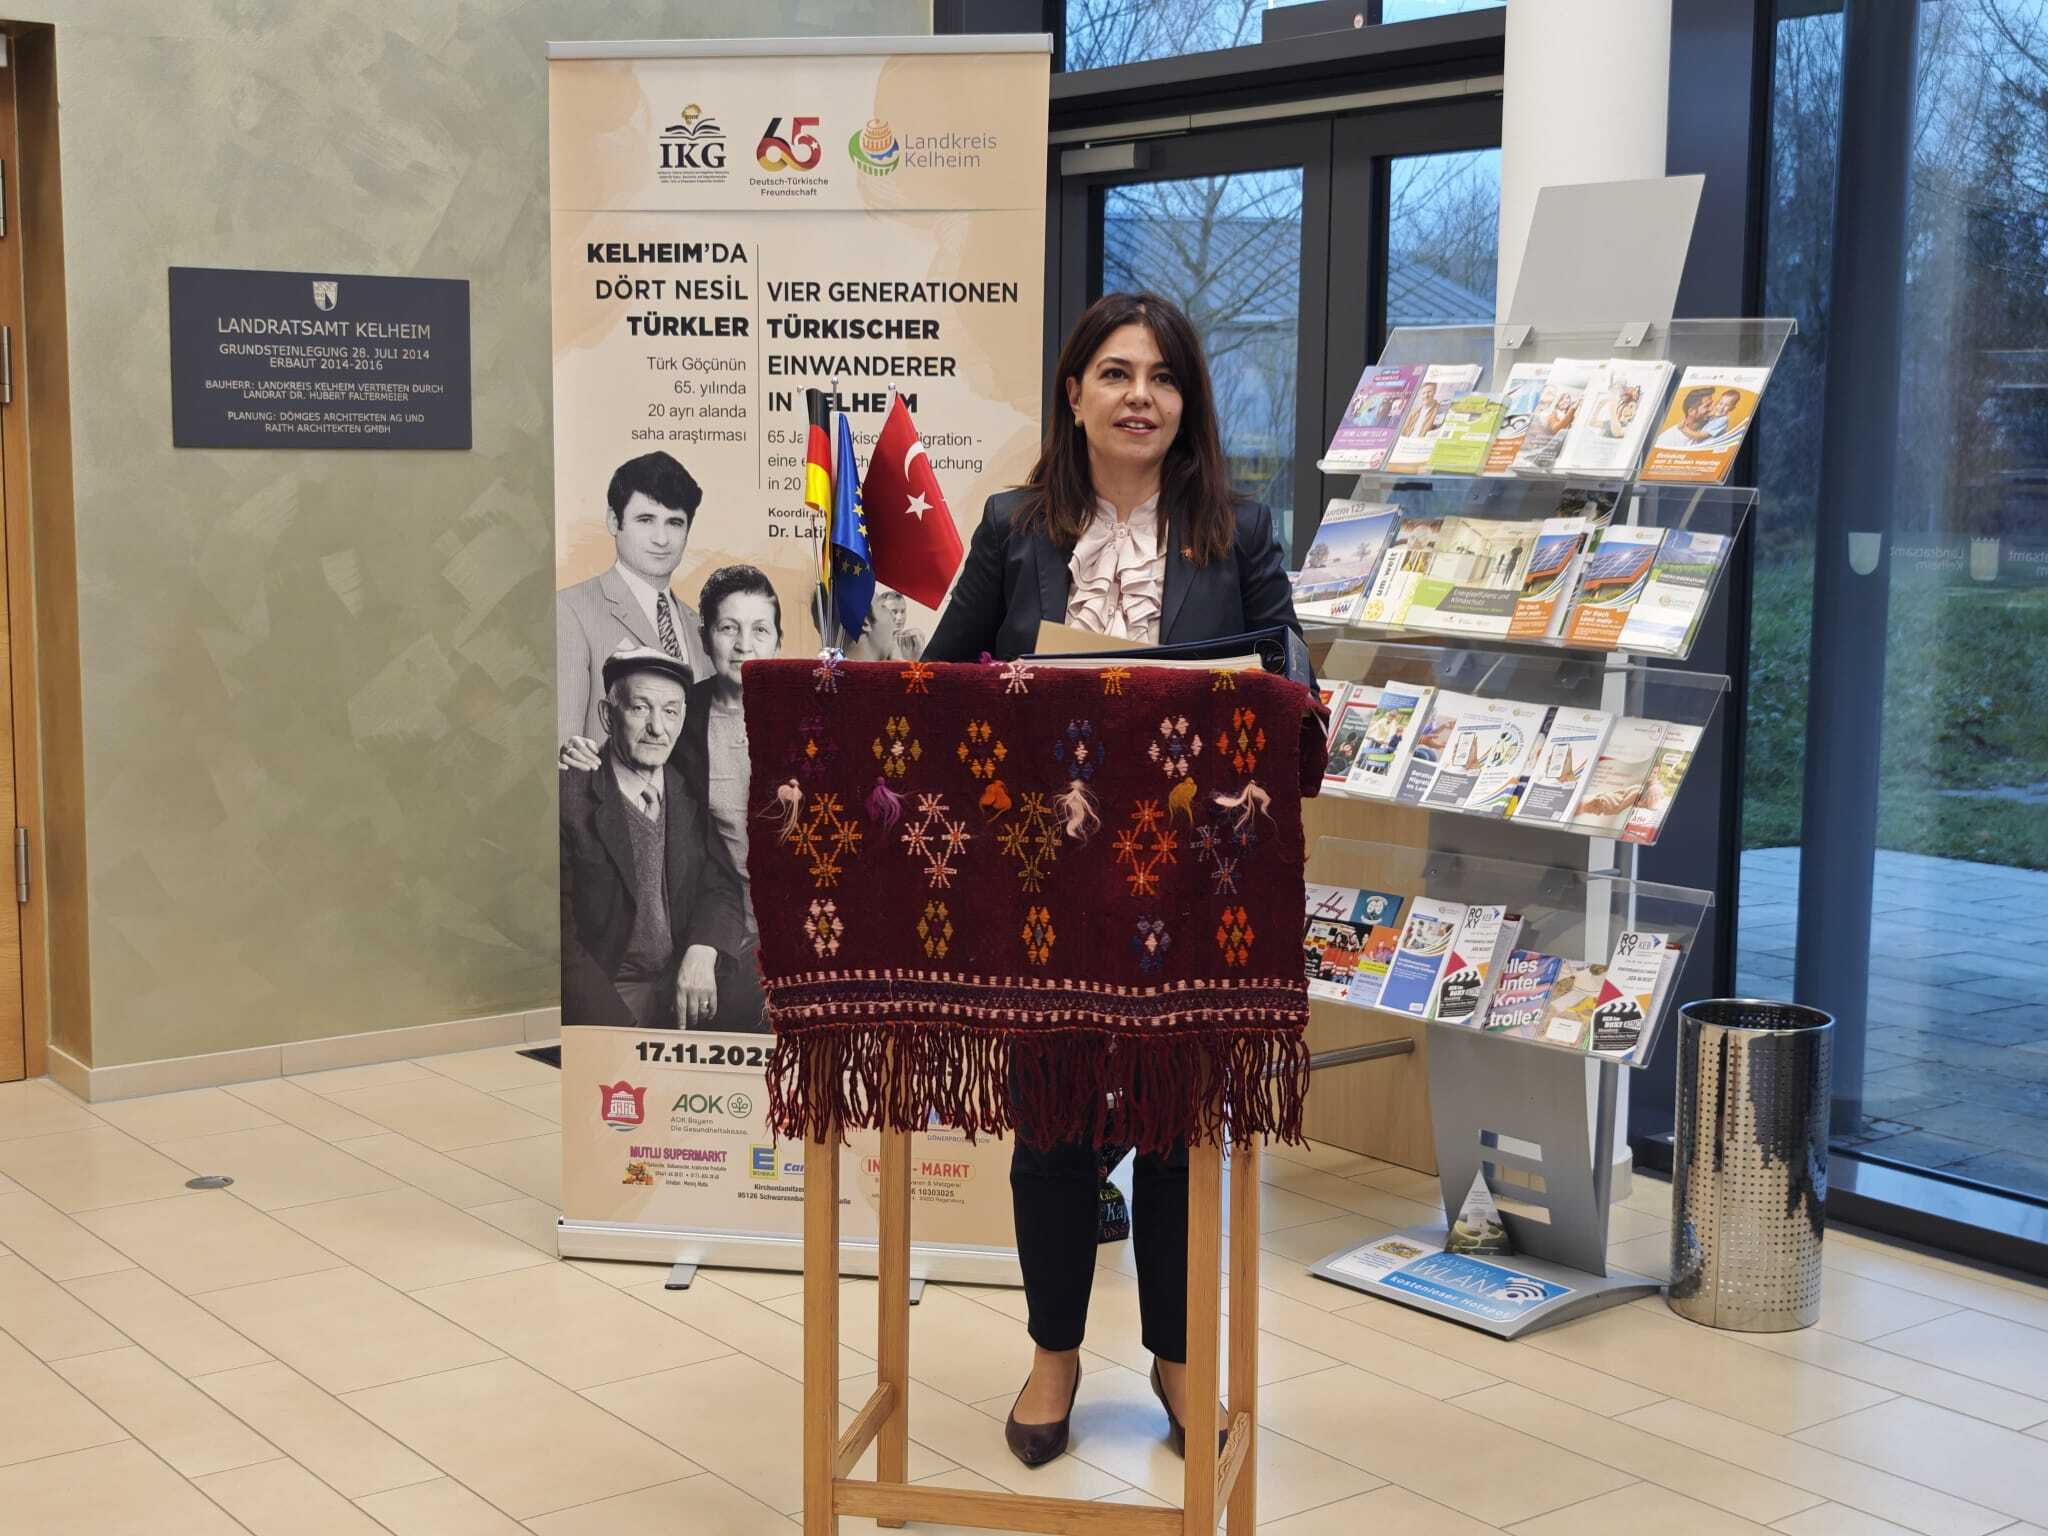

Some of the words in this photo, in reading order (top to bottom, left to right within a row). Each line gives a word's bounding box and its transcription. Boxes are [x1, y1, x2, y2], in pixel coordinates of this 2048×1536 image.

[756, 117, 822, 172] 65
[905, 133, 997, 149] Landkreis
[659, 143, 726, 168] IKG
[905, 152, 981, 169] Kelheim
[749, 177, 829, 187] Deutsch-Türkische
[761, 187, 817, 197] Freundschaft
[596, 275, 666, 300] DÖRT
[676, 275, 749, 301] NESİL
[767, 282, 820, 302] VIER
[829, 282, 1018, 303] GENERATIONEN
[218, 318, 349, 337] LANDRATSAMT
[356, 323, 431, 340] KELHEIM
[627, 312, 750, 337] TÜRKLER
[767, 314, 940, 340] TÜRKISCHER
[219, 344, 348, 359] GRUNDSTEINLEGUNG
[352, 347, 371, 359] 28.
[374, 348, 398, 360] JULI
[402, 349, 430, 360] 2014
[270, 357, 316, 369] ERBAUT
[321, 358, 383, 370] 2014-2016
[647, 356, 678, 371] Türk
[682, 356, 747, 374] Göçünün
[768, 355, 957, 377] EINWANDERER
[205, 380, 255, 390] BAUHERR:
[258, 381, 312, 391] LANDKREIS
[315, 382, 355, 392] KELHEIM
[358, 383, 409, 393] VERTRETEN
[412, 384, 444, 393] DURCH
[674, 380, 697, 395] 65.
[700, 380, 747, 398] yılında
[243, 390, 287, 400] LANDRAT
[290, 391, 306, 400] DR.
[309, 391, 346, 400] HUBERT
[349, 392, 408, 401] FALTERMEIER
[769, 392, 792, 411] IN
[822, 393, 918, 413] ELHEM
[228, 411, 276, 421] PLANUNG:
[323, 413, 386, 423] ARCHITEKTEN
[390, 413, 402, 423] AG
[405, 414, 424, 423] UND
[648, 403, 665, 418] 20
[669, 404, 695, 421] ayrı
[699, 403, 747, 419] alanda
[265, 423, 294, 432] RAITH
[297, 423, 361, 433] ARCHITEKTEN
[364, 424, 390, 433] GMBH
[631, 427, 665, 442] saha
[668, 428, 747, 445] araştırması
[768, 431, 785, 444] 65
[919, 432, 972, 448] igration
[768, 456, 797, 467] eine
[768, 478, 779, 490] in
[784, 478, 801, 490] 20
[768, 525, 789, 538] Dr.
[795, 525, 825, 538] Lati
[1507, 959, 1538, 972] lles
[1489, 1008, 1543, 1026] trolle?
[671, 1094, 724, 1113] AOK
[630, 1146, 662, 1159] MUTLU
[664, 1149, 727, 1163] SUPERMARKT
[922, 1162, 970, 1178] MARKT
[1413, 1261, 1499, 1297] WLAN
[1390, 1276, 1457, 1300] kostenloser
